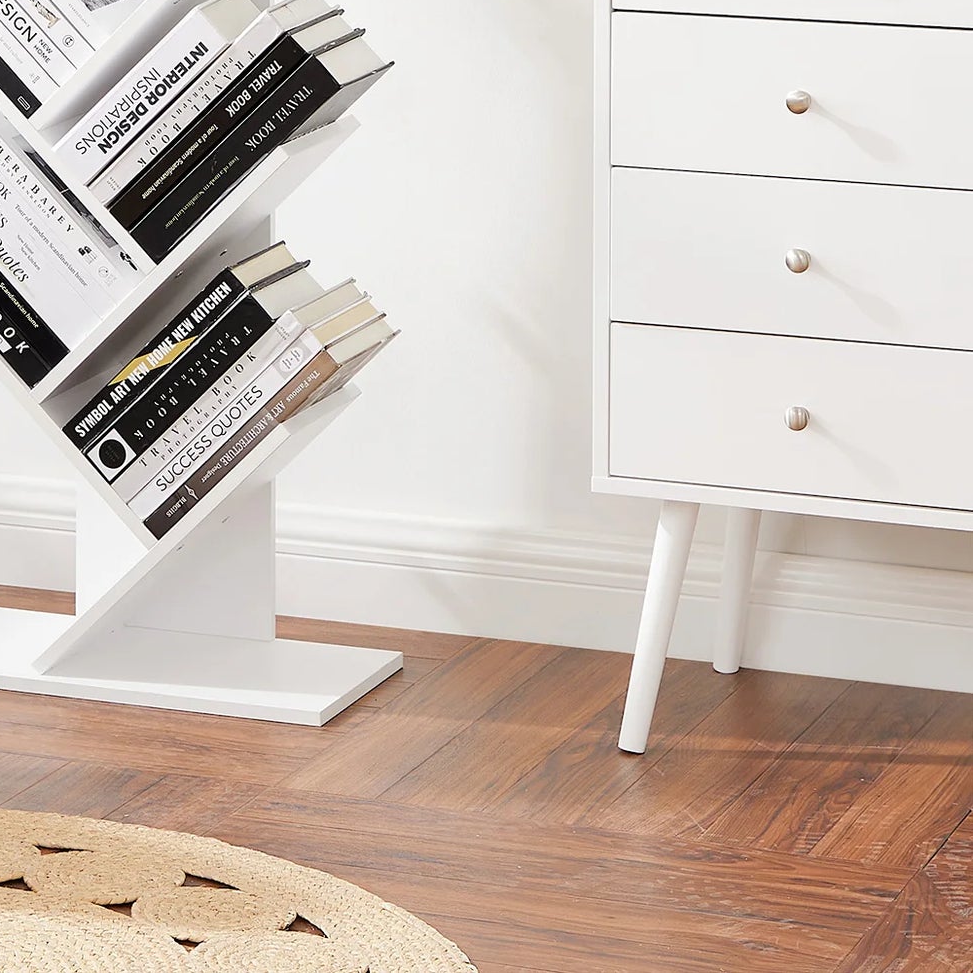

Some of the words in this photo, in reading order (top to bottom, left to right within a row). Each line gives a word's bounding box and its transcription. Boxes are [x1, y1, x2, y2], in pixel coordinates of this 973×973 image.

[33, 45, 51, 63] HOME
[39, 39, 53, 54] NEW
[146, 41, 209, 106] INTERIOR
[170, 57, 234, 121] PHOTOGRAPHY
[191, 50, 256, 112] TRAVEL
[248, 60, 283, 95] TRAVEL
[76, 67, 161, 155] INSPIRATIONS
[225, 90, 252, 118] BOOK
[275, 84, 314, 124] TRAVEL
[98, 103, 148, 154] DESIGN
[137, 123, 182, 168] BOOK
[144, 122, 167, 146] FOOD
[182, 141, 201, 160] modern
[206, 124, 219, 136] Tour
[244, 121, 277, 152] BOOK
[142, 183, 157, 199] home
[154, 157, 185, 187] Scandinavian
[31, 184, 74, 234] BAREY
[15, 204, 26, 216] Tour
[32, 223, 49, 244] modern
[49, 242, 75, 275] Scandinavian
[74, 272, 88, 286] home
[0, 282, 27, 315] Scandinavian
[26, 313, 39, 328] home
[74, 399, 114, 437] SYMBOL
[109, 378, 132, 404] ART
[127, 362, 150, 386] NEW
[146, 336, 177, 367] HOME
[171, 317, 195, 343] NEW
[191, 281, 233, 324] KITCHEN
[154, 332, 231, 406] PHOTOGRAPHY
[188, 325, 253, 388] TRAVEL
[308, 370, 321, 382] The
[138, 406, 203, 468] TRAVEL
[212, 351, 257, 397] BOOK
[272, 401, 286, 417] ART
[287, 380, 310, 403] Famous
[134, 396, 179, 441] BOOK
[156, 434, 212, 492] SUCCESS
[211, 385, 263, 438] QUOTES
[159, 385, 238, 461] PHOTOGRAPHY
[267, 413, 274, 422] &
[220, 419, 269, 467] ARCHITECTURE
[201, 464, 222, 483] Designer
